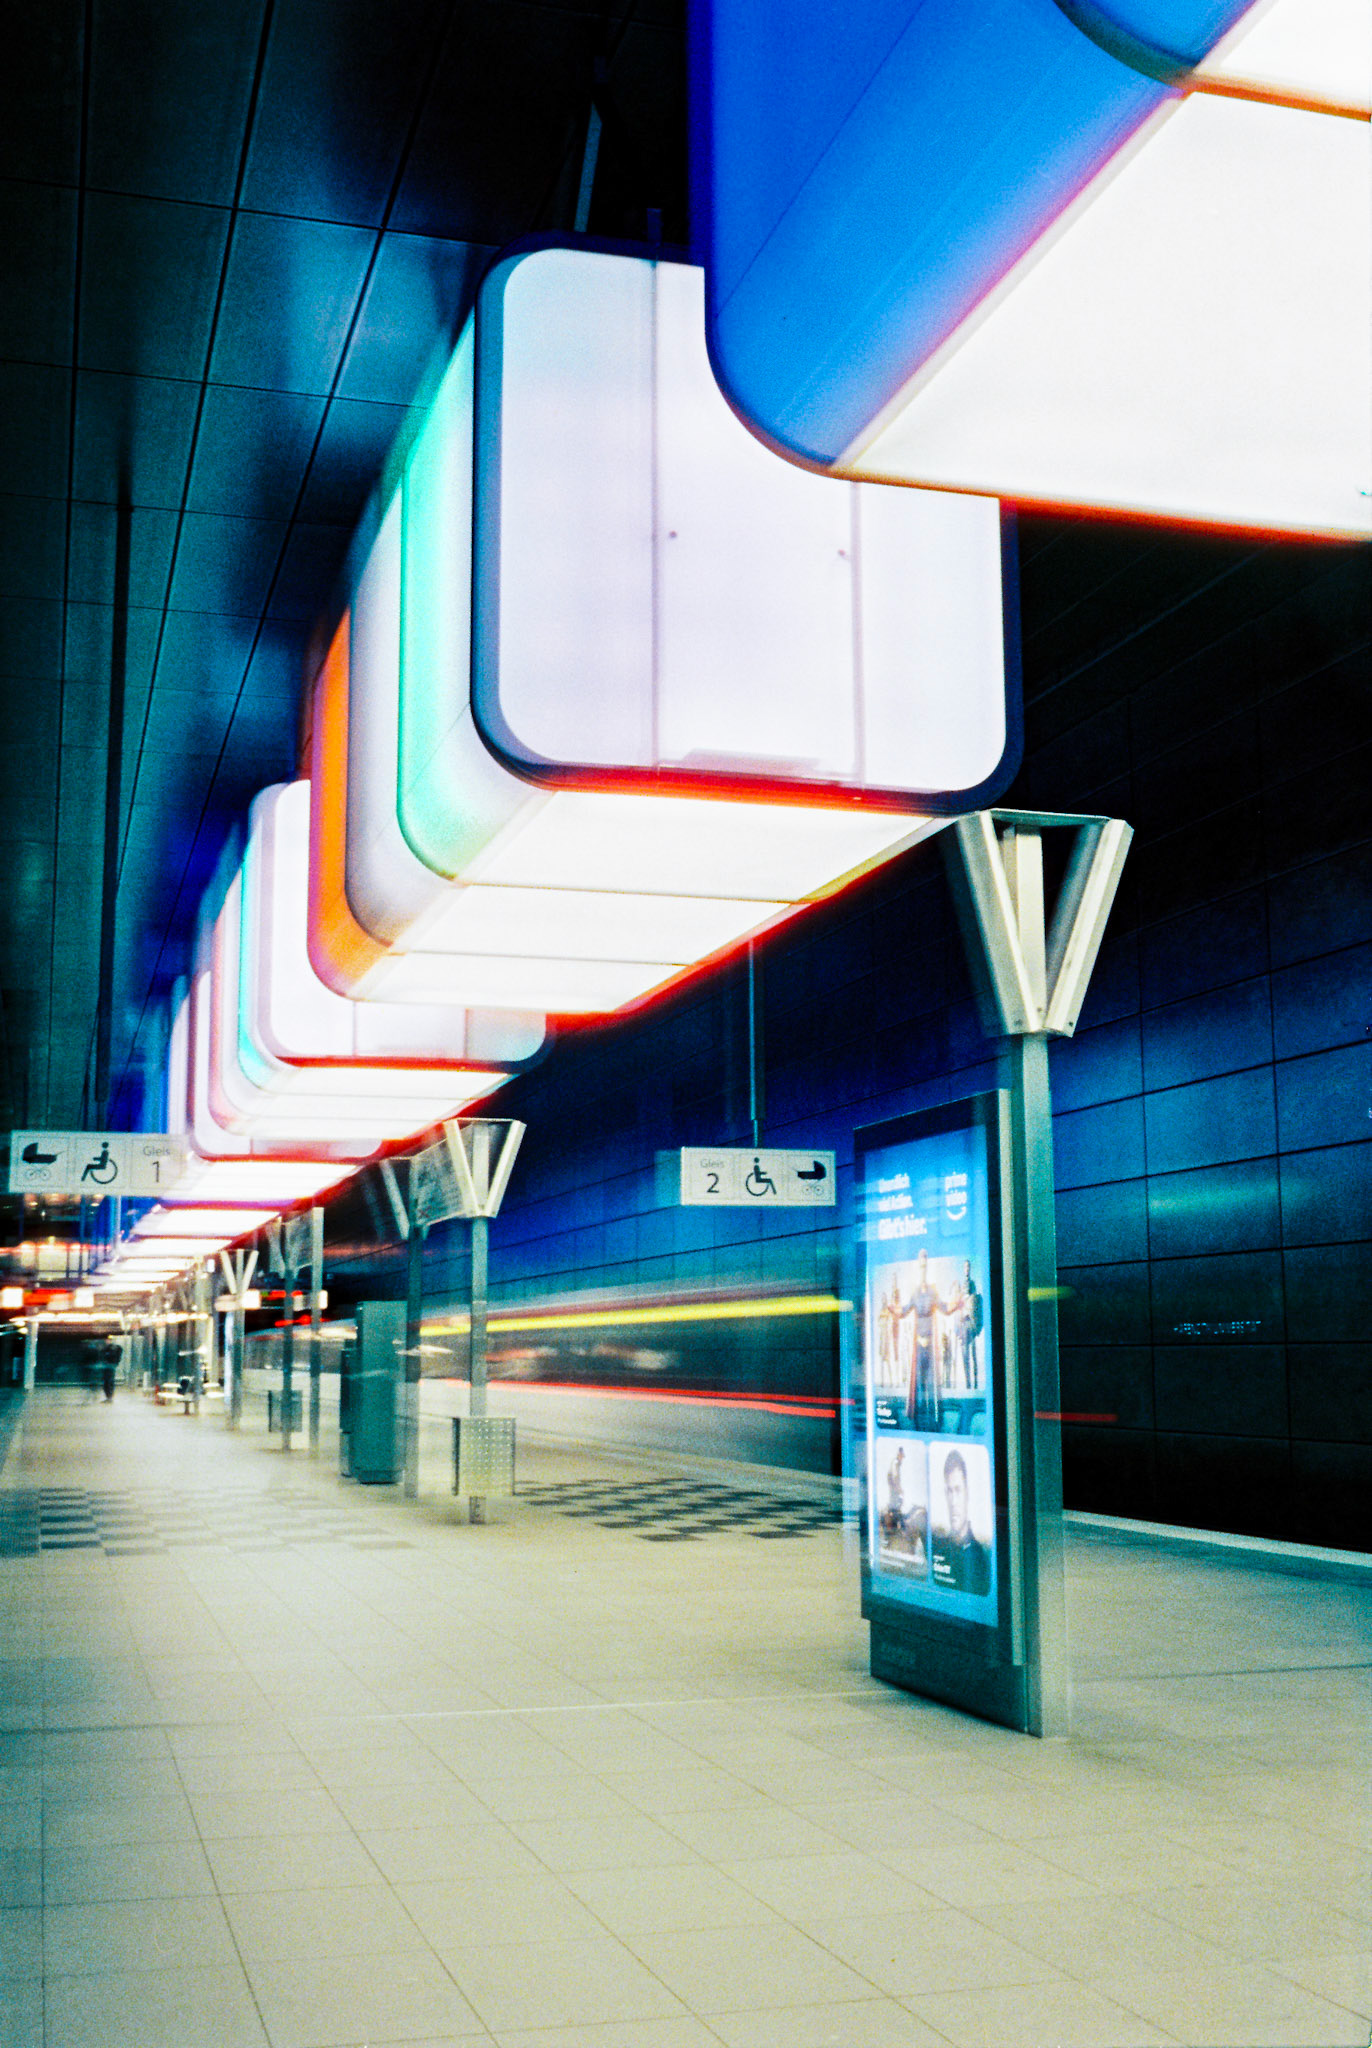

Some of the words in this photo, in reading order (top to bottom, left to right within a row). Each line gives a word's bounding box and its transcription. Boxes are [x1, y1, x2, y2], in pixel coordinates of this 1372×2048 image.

[143, 1145, 171, 1156] Gleis
[700, 1158, 725, 1168] Gleis
[151, 1160, 160, 1183] 1
[706, 1172, 720, 1193] 2
